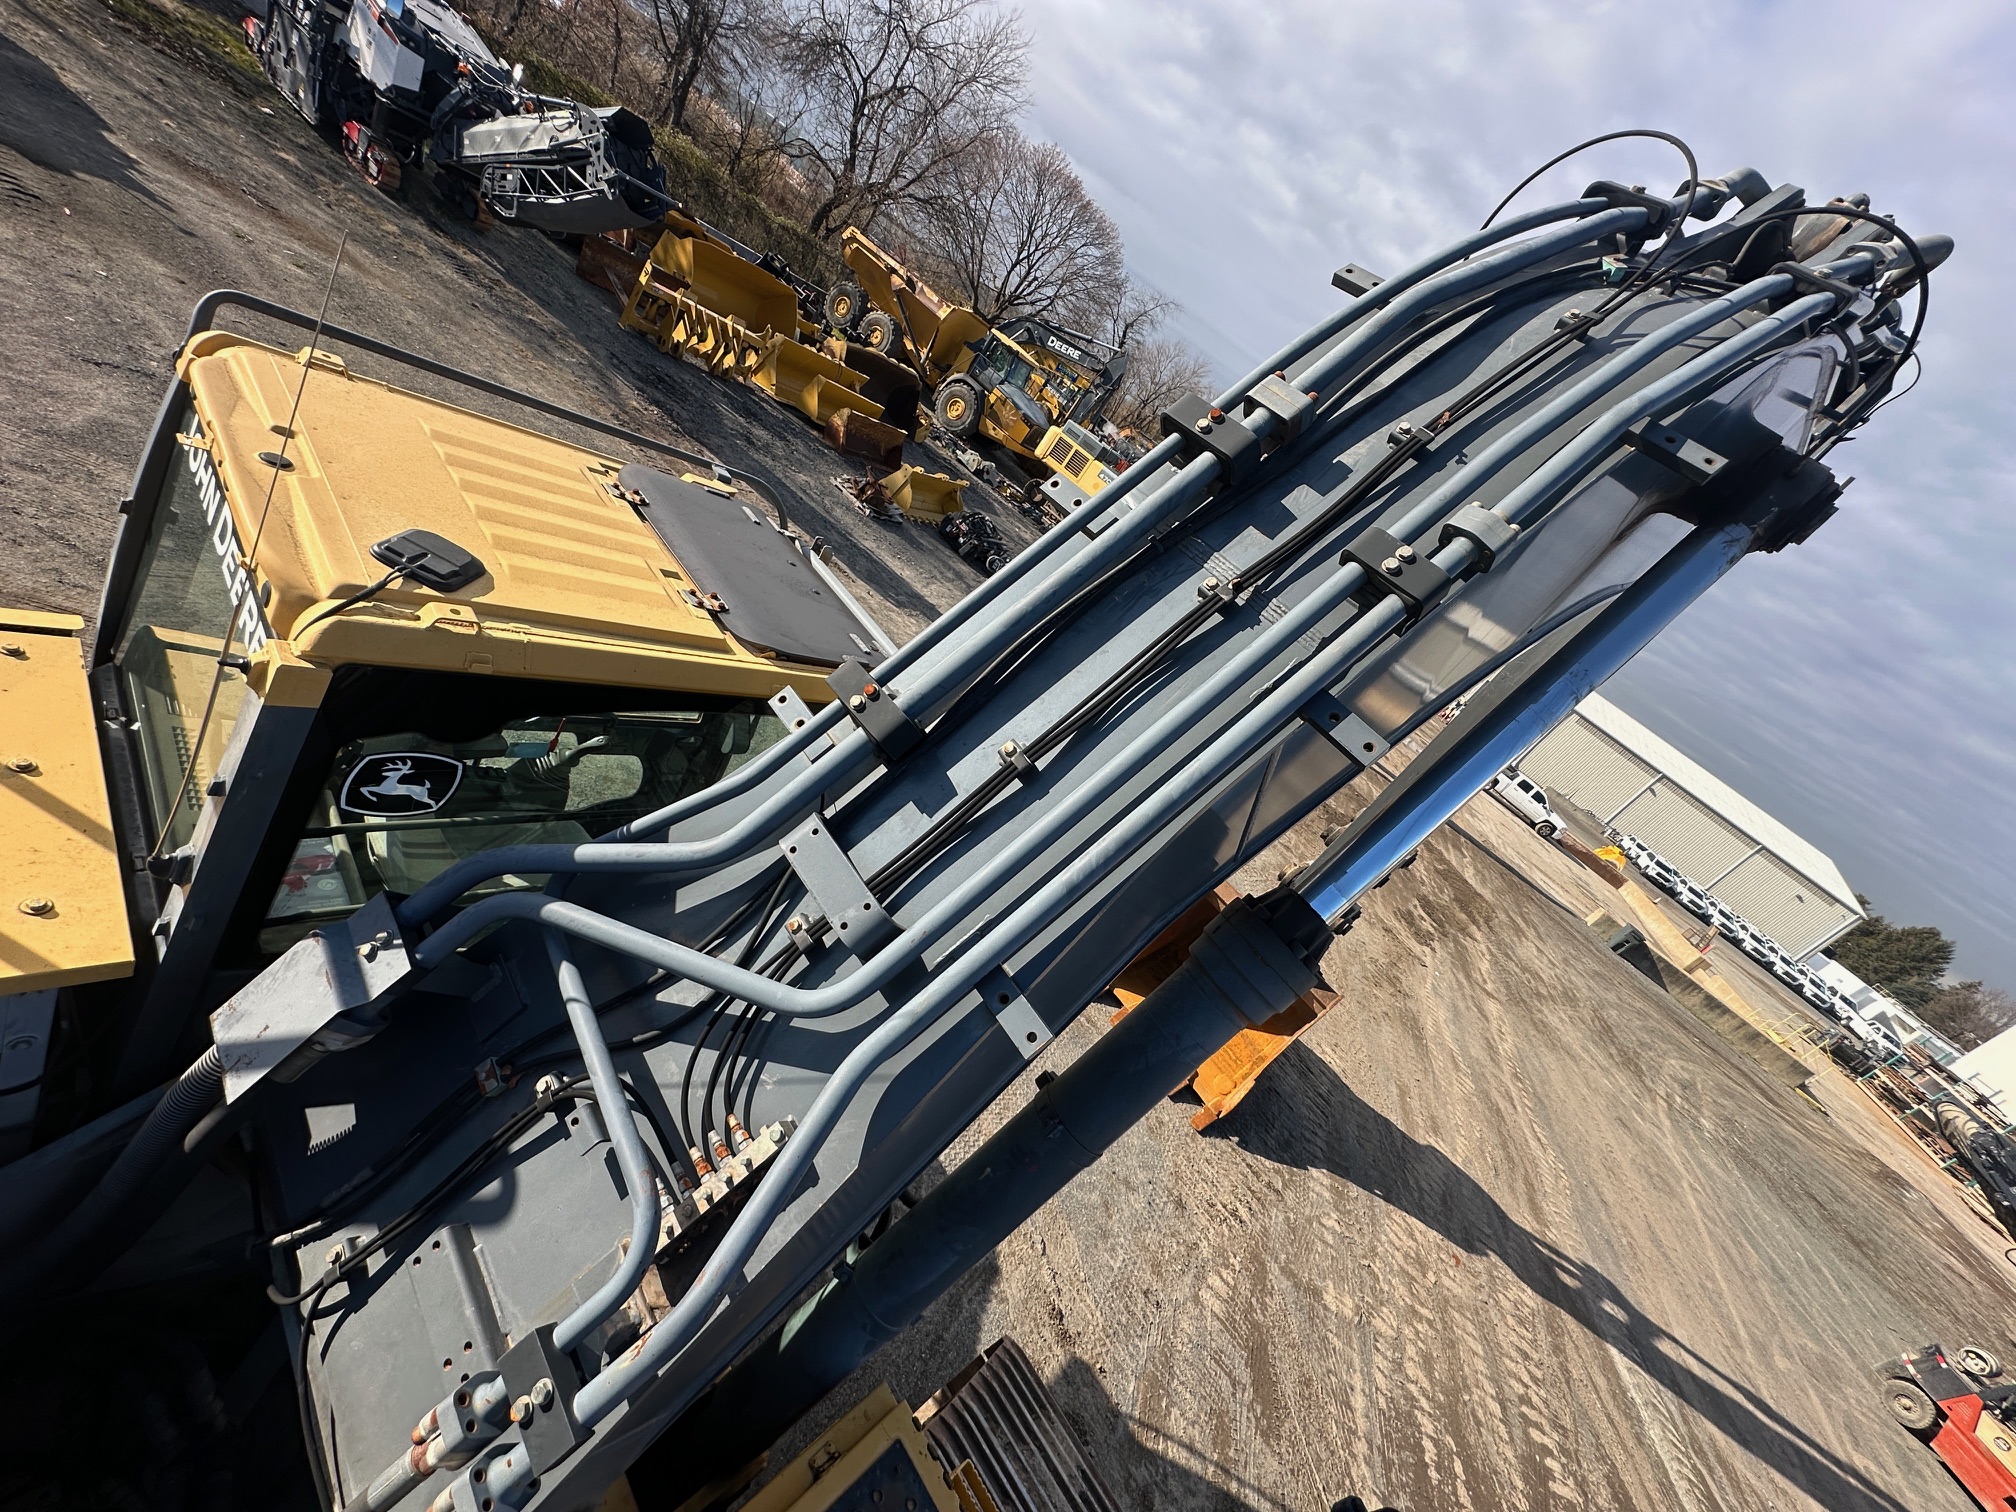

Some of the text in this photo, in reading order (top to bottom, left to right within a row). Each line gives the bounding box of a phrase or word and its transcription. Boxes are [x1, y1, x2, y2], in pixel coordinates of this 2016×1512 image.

[1046, 335, 1082, 360] DEERE
[182, 412, 268, 655] JOHN DEERE
